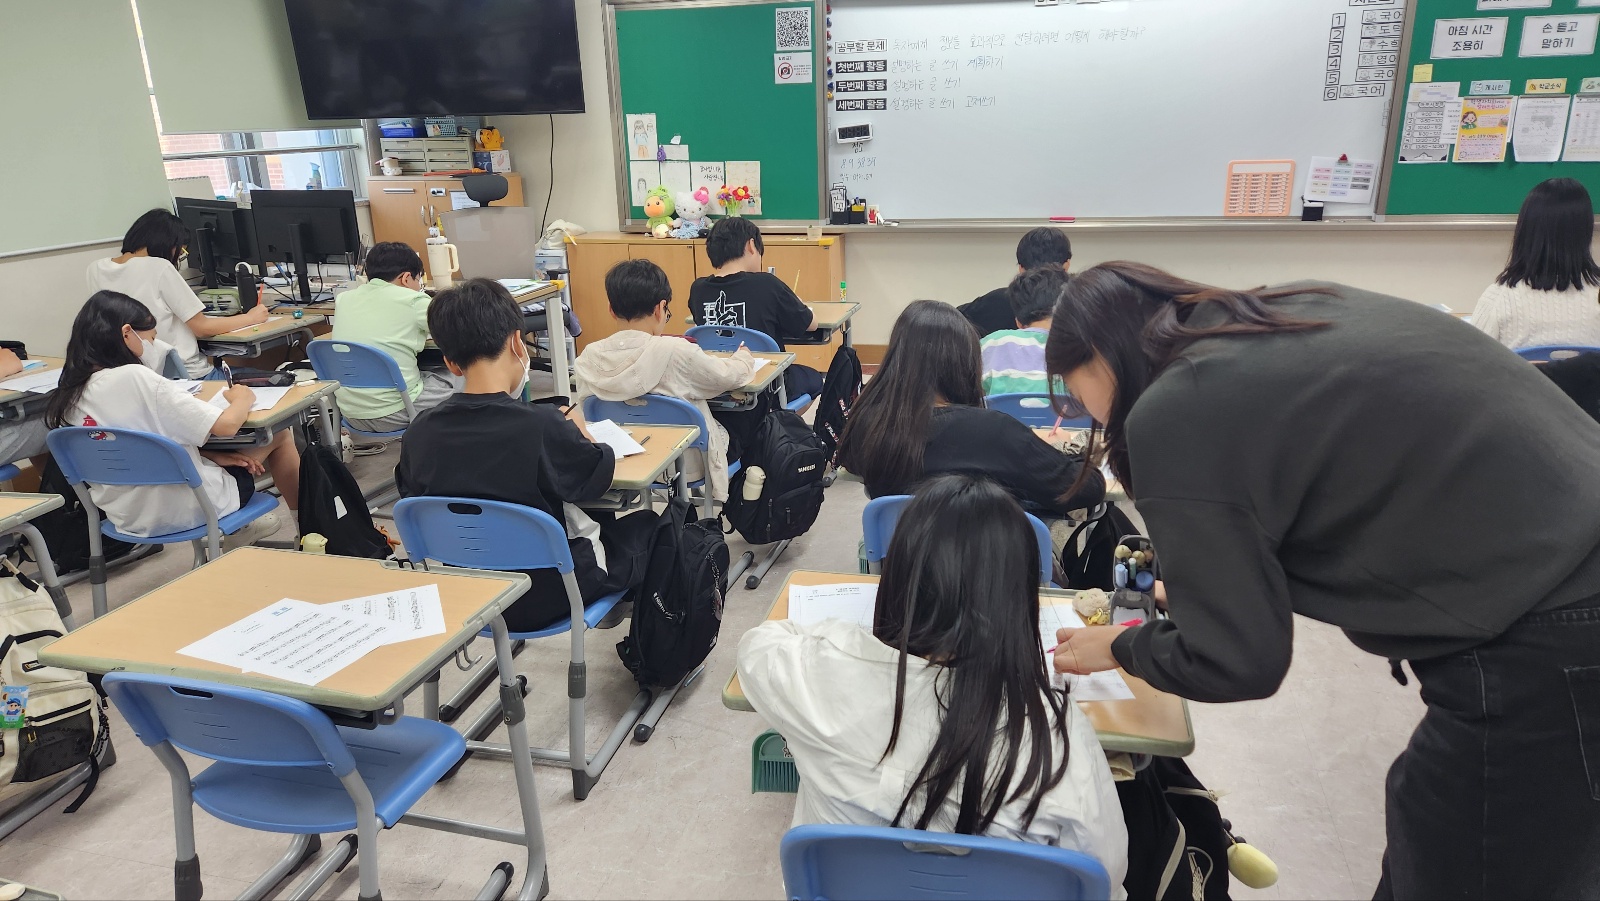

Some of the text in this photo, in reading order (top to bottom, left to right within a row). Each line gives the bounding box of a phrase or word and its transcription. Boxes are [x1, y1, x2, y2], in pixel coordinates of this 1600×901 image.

[1336, 16, 1340, 25] 1
[1448, 25, 1494, 36] 아침 시간
[1542, 22, 1553, 34] 손
[1333, 30, 1342, 39] 2
[838, 41, 885, 53] 공부할 문제
[1452, 40, 1484, 51] 조용히
[1542, 38, 1574, 49] 말하기
[1331, 45, 1339, 54] 3
[838, 61, 885, 73] 첫번째 활동
[1329, 59, 1338, 68] 4
[1329, 74, 1337, 83] 5
[838, 80, 885, 91] 두번째 활동
[1357, 86, 1382, 95] 국어
[1327, 89, 1335, 98] 6
[838, 99, 885, 110] 세번째 활동
